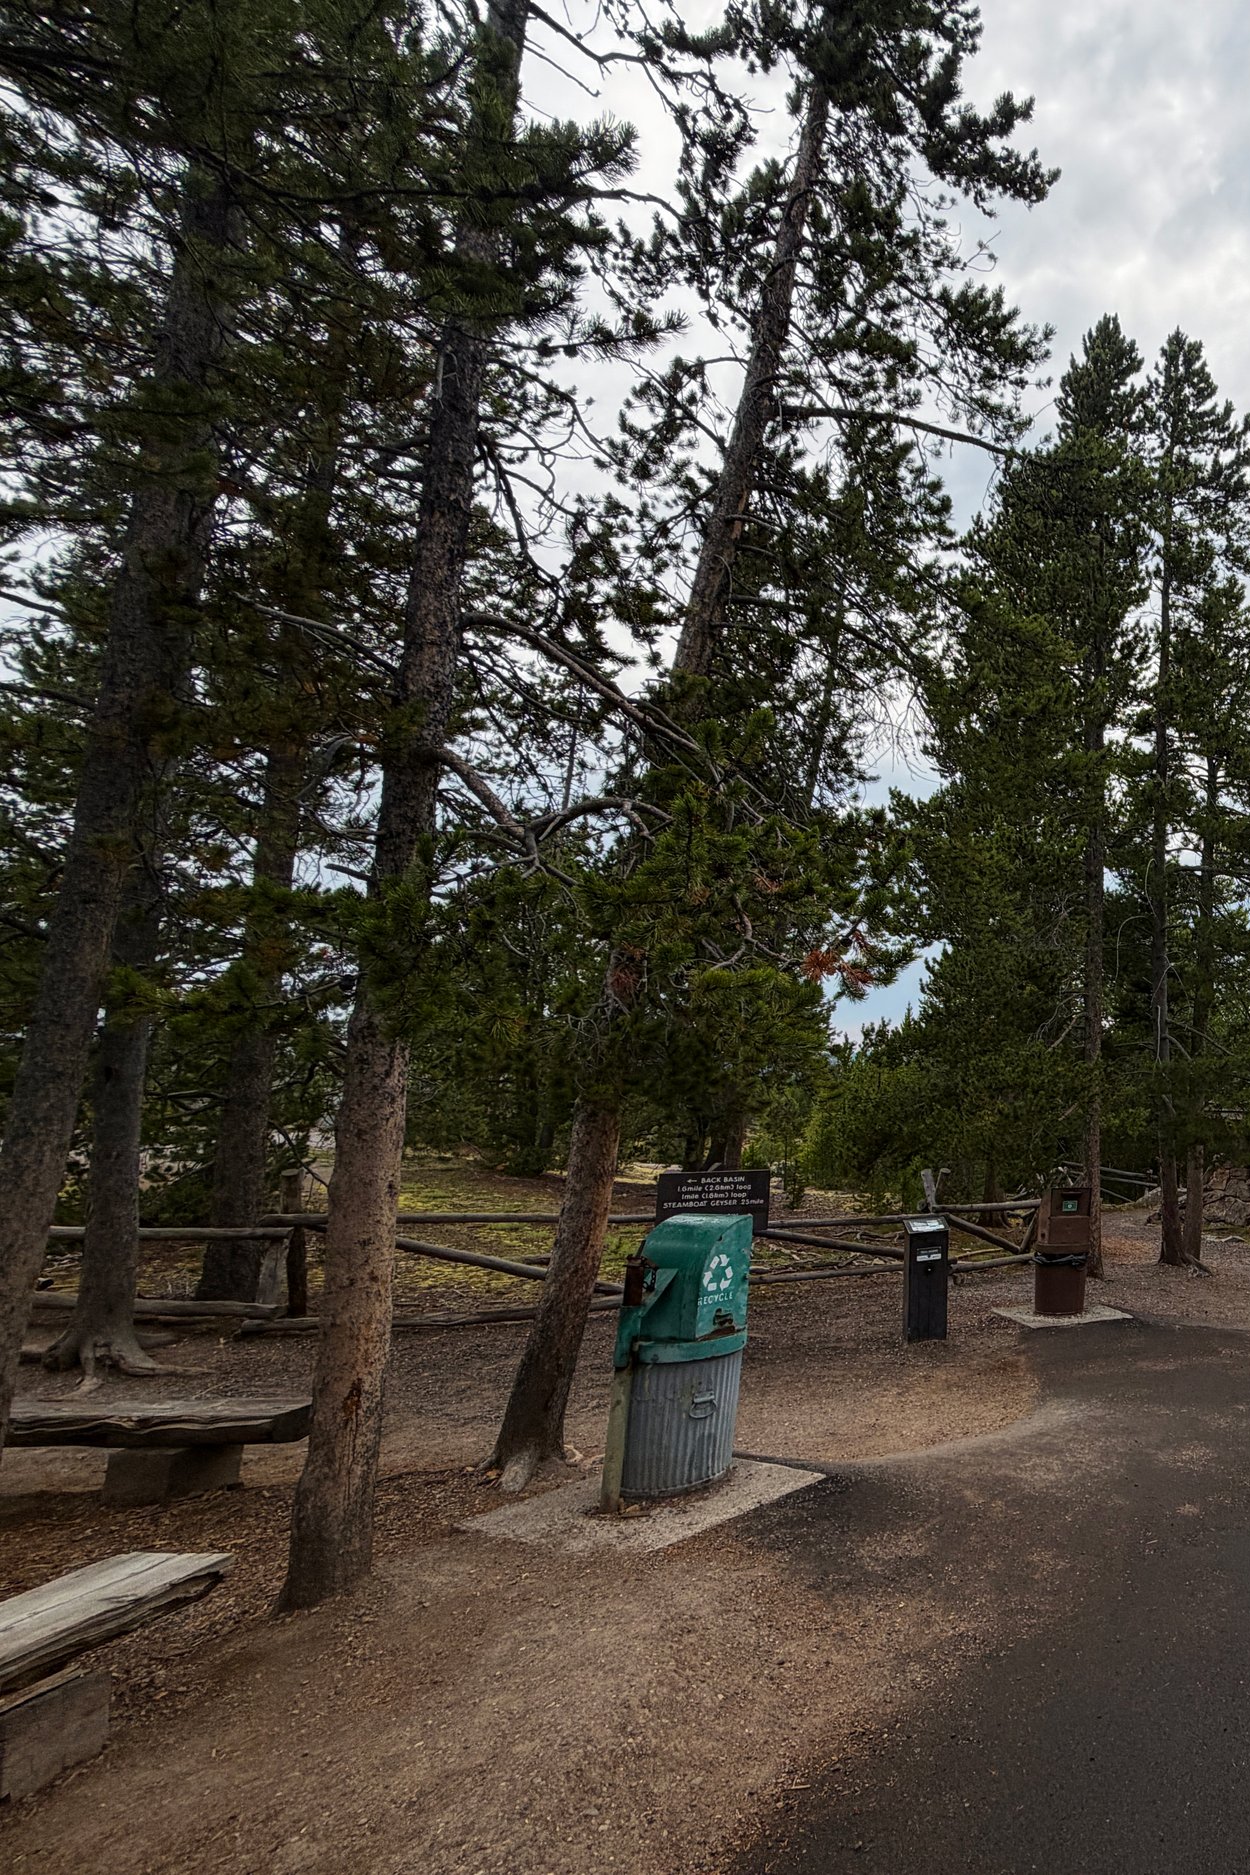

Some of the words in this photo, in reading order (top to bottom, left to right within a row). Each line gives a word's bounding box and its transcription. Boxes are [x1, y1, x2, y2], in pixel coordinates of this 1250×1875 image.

[730, 1191, 747, 1199] loop
[663, 1200, 708, 1209] STEAMBOAT
[697, 1291, 733, 1306] RECYCLE
